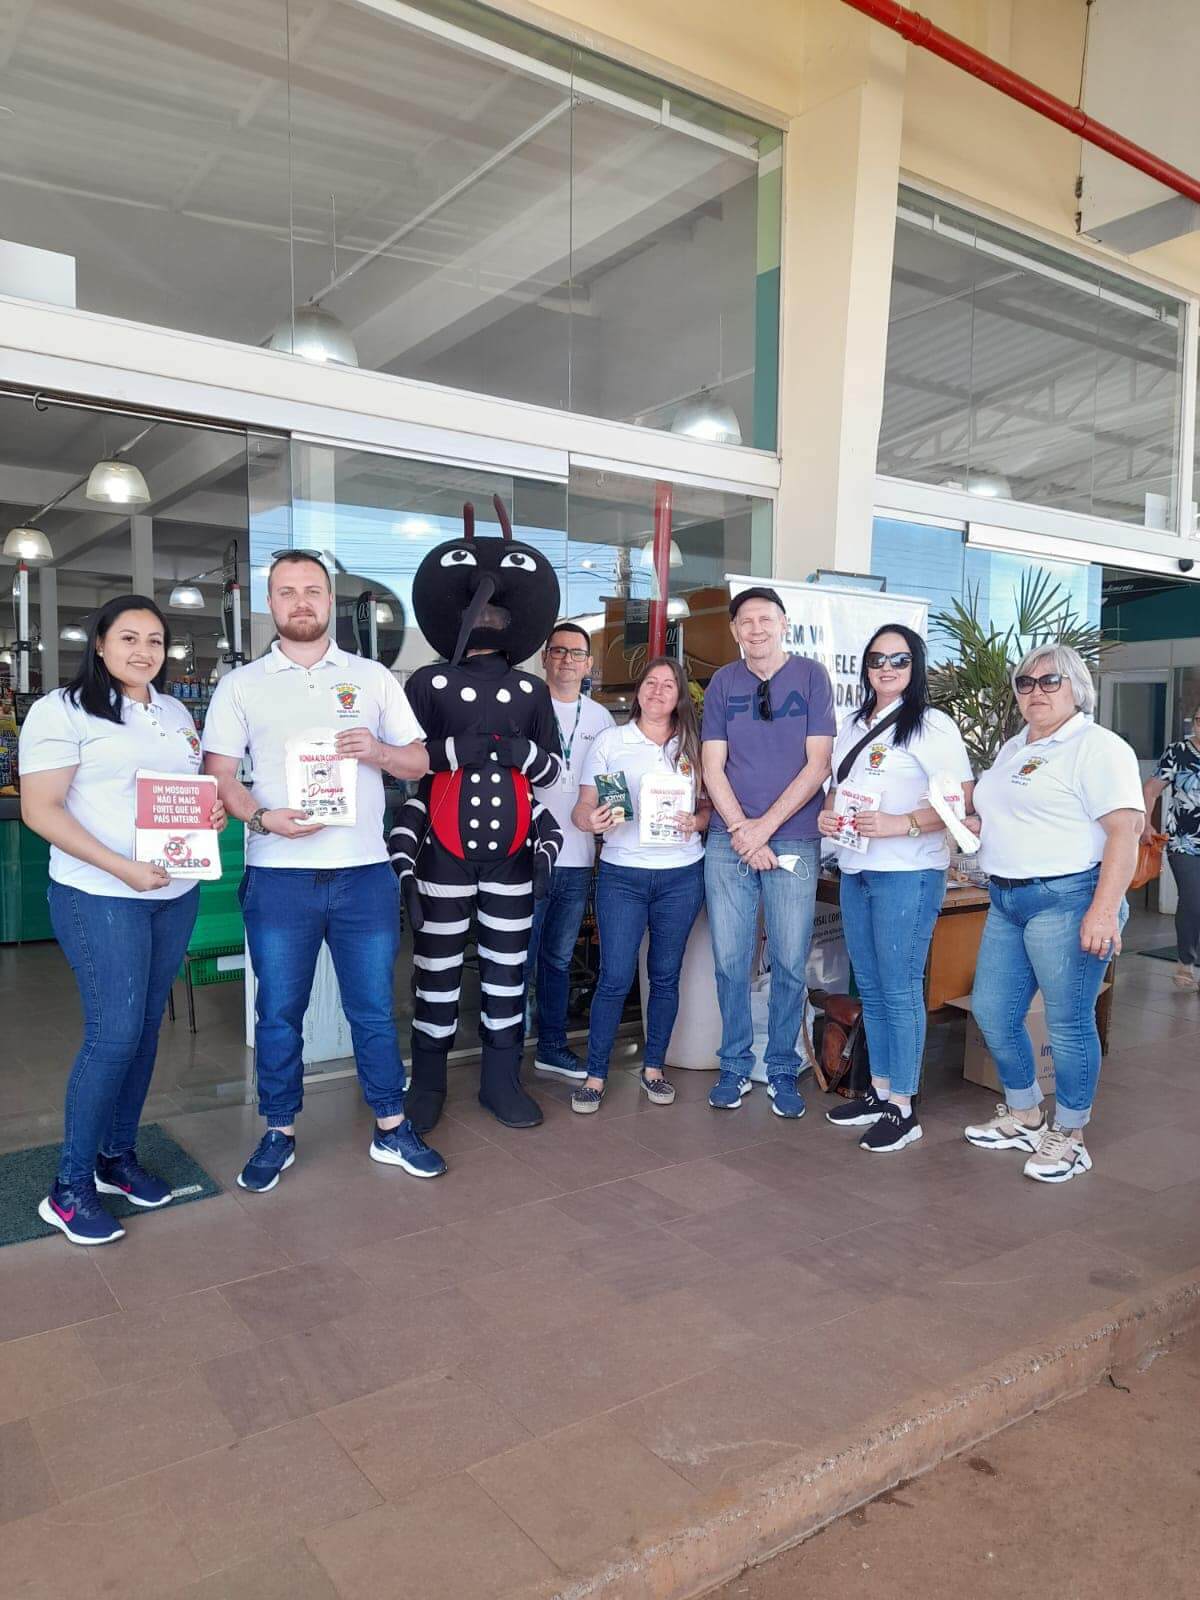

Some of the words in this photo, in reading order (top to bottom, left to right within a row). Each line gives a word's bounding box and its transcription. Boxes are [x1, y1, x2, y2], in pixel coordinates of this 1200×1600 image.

[152, 785, 164, 794] UM
[165, 785, 200, 795] MOSQUITO
[308, 783, 344, 798] Dengue
[178, 796, 196, 804] MAIS
[152, 805, 173, 814] FORTE
[175, 805, 188, 814] QUE
[190, 805, 201, 814] UM
[171, 814, 201, 824] INTEIRO.
